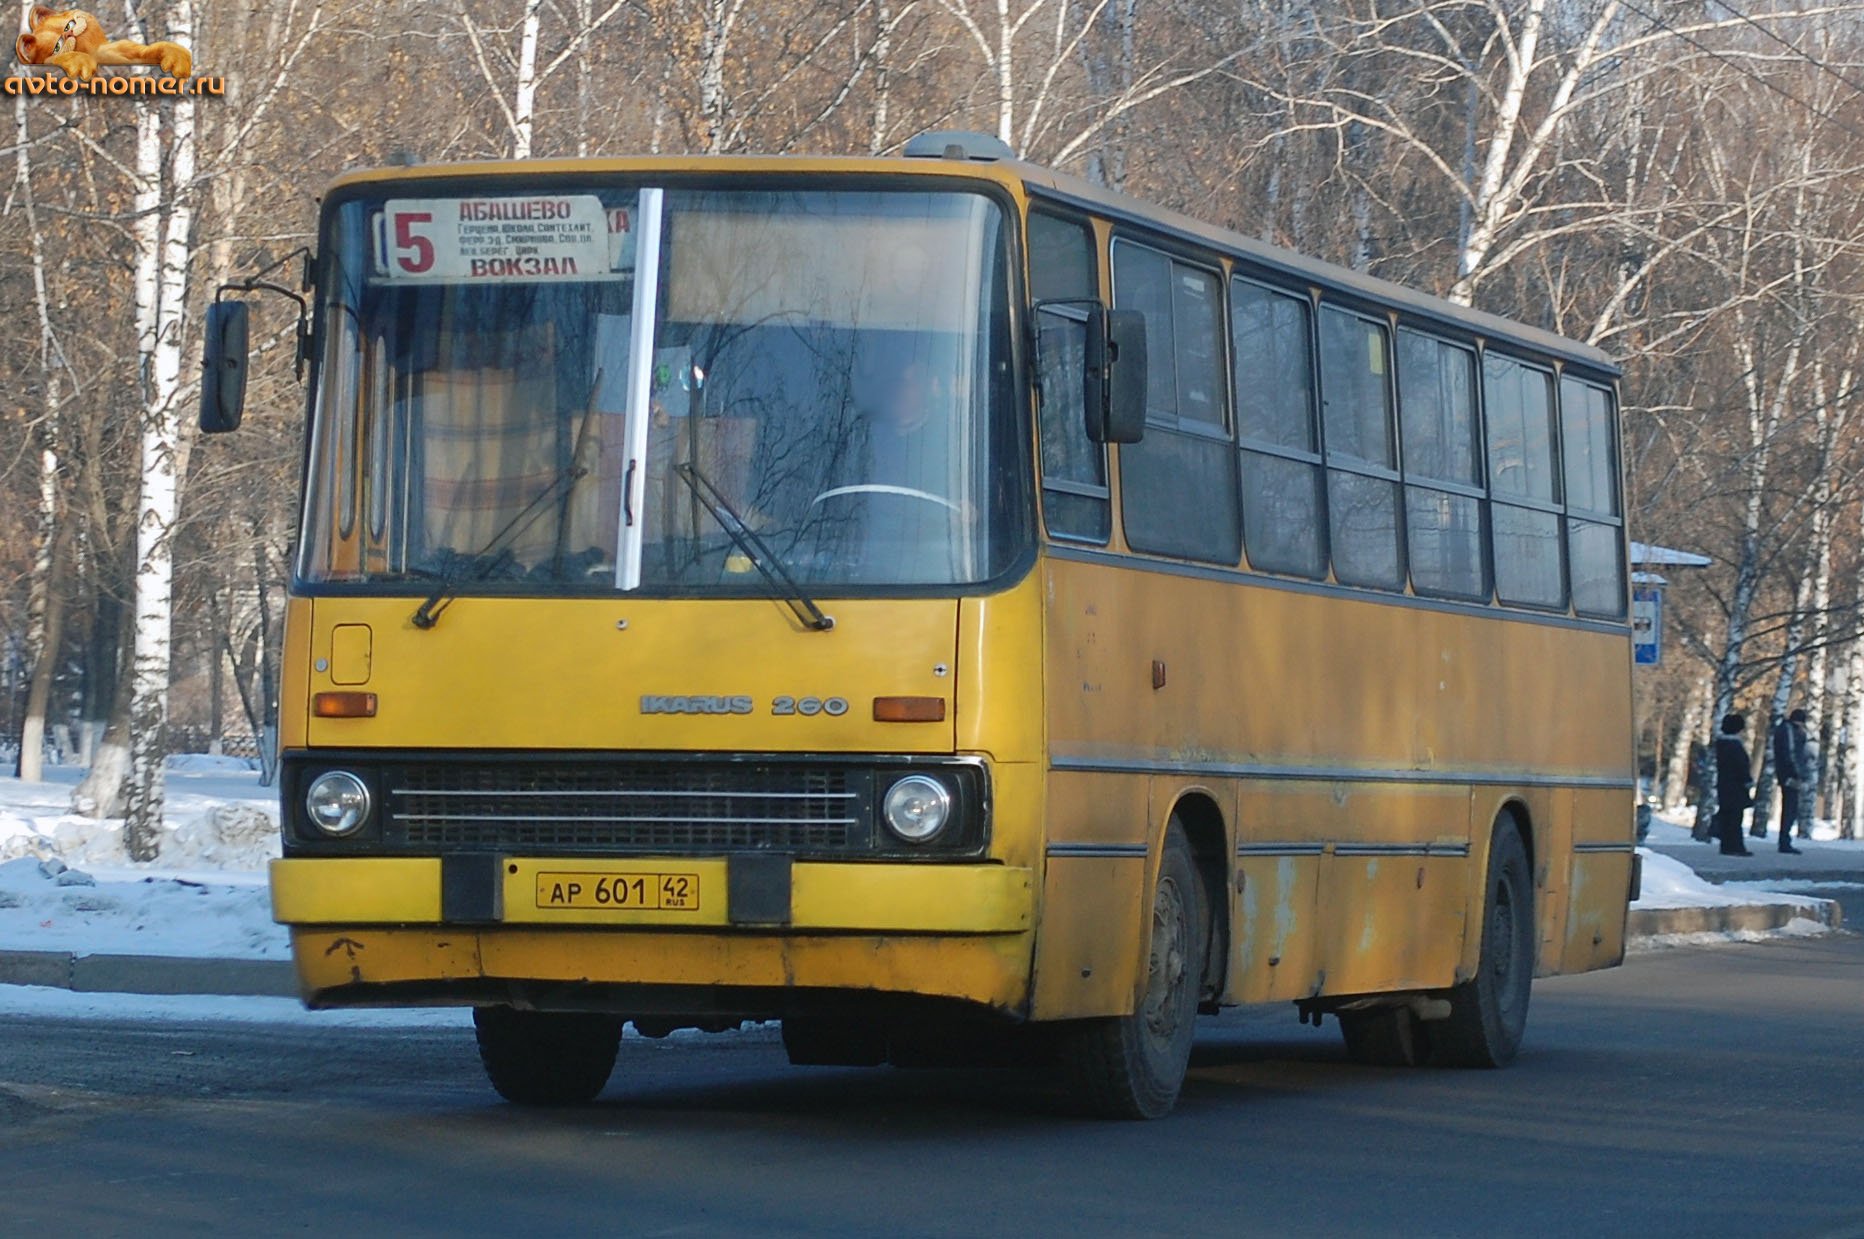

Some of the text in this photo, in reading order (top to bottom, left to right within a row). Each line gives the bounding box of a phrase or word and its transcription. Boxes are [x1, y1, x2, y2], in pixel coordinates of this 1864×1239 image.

[460, 201, 571, 221] АБАШЕВО
[395, 212, 435, 273] 5
[471, 257, 577, 277] ВОКЗАЛ
[640, 695, 849, 716] IKARUS 260
[595, 878, 645, 905] 601
[663, 877, 689, 898] 42
[665, 898, 686, 907] RUS
